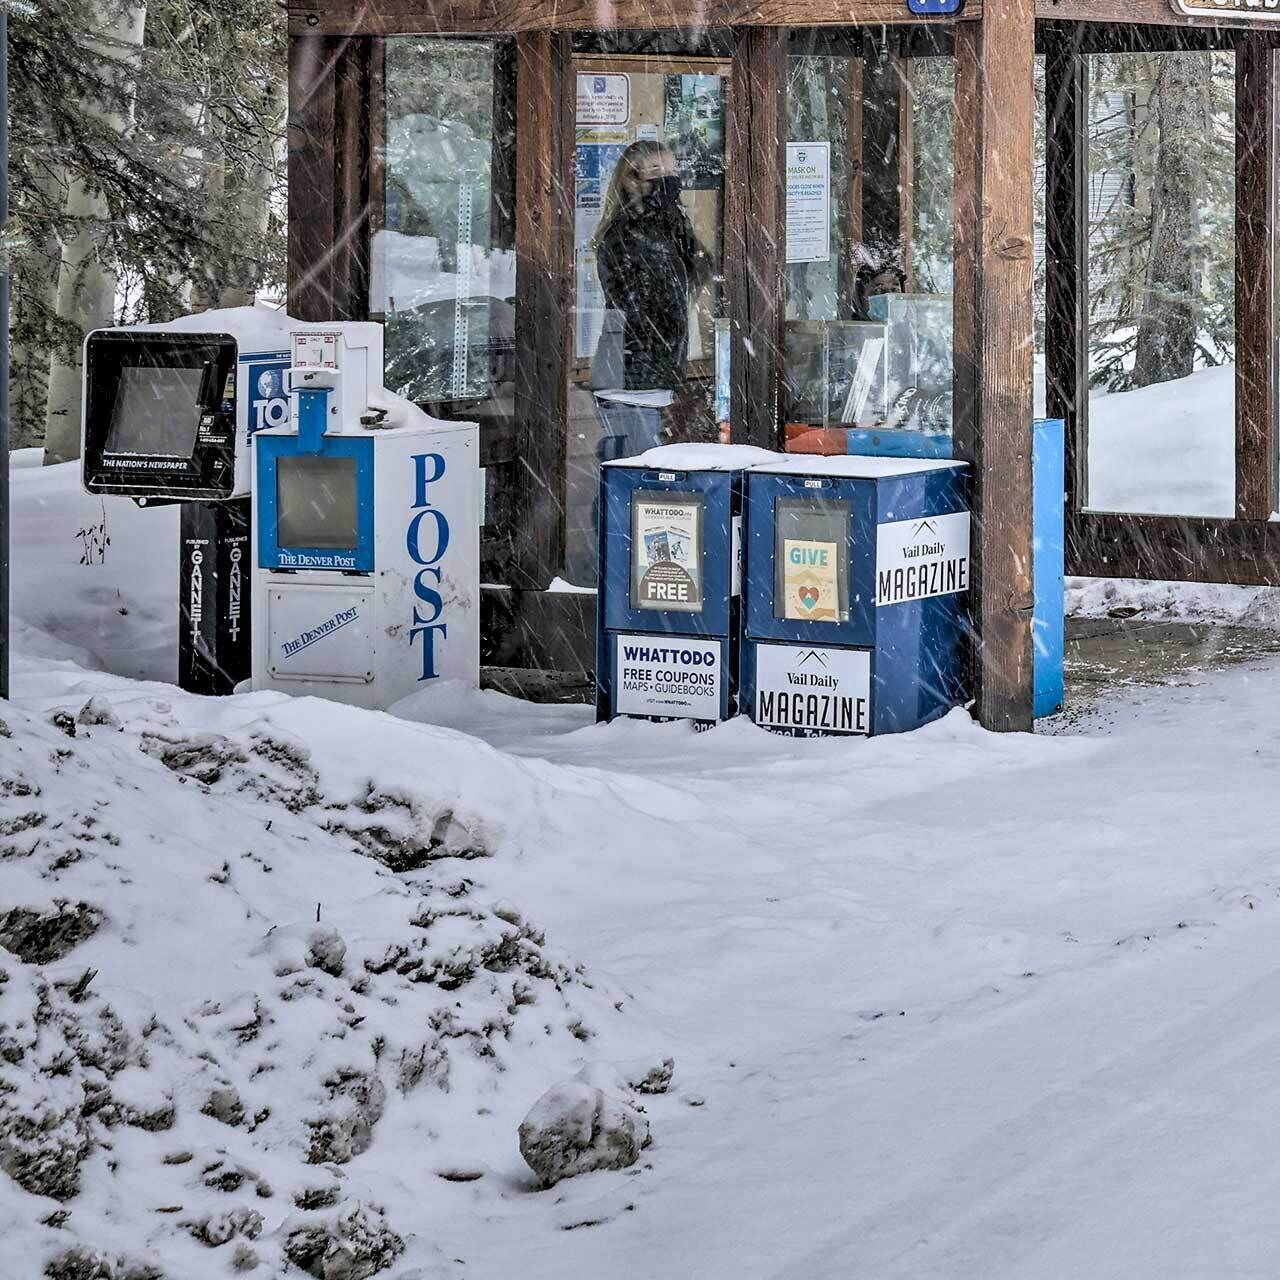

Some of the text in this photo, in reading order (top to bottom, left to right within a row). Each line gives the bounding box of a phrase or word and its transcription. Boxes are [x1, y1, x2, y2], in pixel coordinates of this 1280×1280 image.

[103, 459, 187, 470] THE NATION'S NEWSPAPER
[805, 480, 821, 488] PULL
[279, 553, 356, 567] THE DENVER POST
[789, 546, 829, 567] GIVE
[902, 541, 946, 559] Vail Daily
[406, 452, 450, 682] POST
[878, 557, 967, 604] MAGAZINE
[190, 550, 204, 645] GANNETT
[229, 548, 242, 642] GANNETT
[647, 582, 688, 601] FREE
[281, 606, 358, 655] THE DENVER POST
[623, 646, 715, 667] WHATTODO
[623, 668, 715, 686] FREE COUPONS
[787, 672, 839, 691] Vail Daily
[623, 681, 715, 697] MAPS GUIDEBOOKS
[759, 690, 866, 731] MAGAZINE
